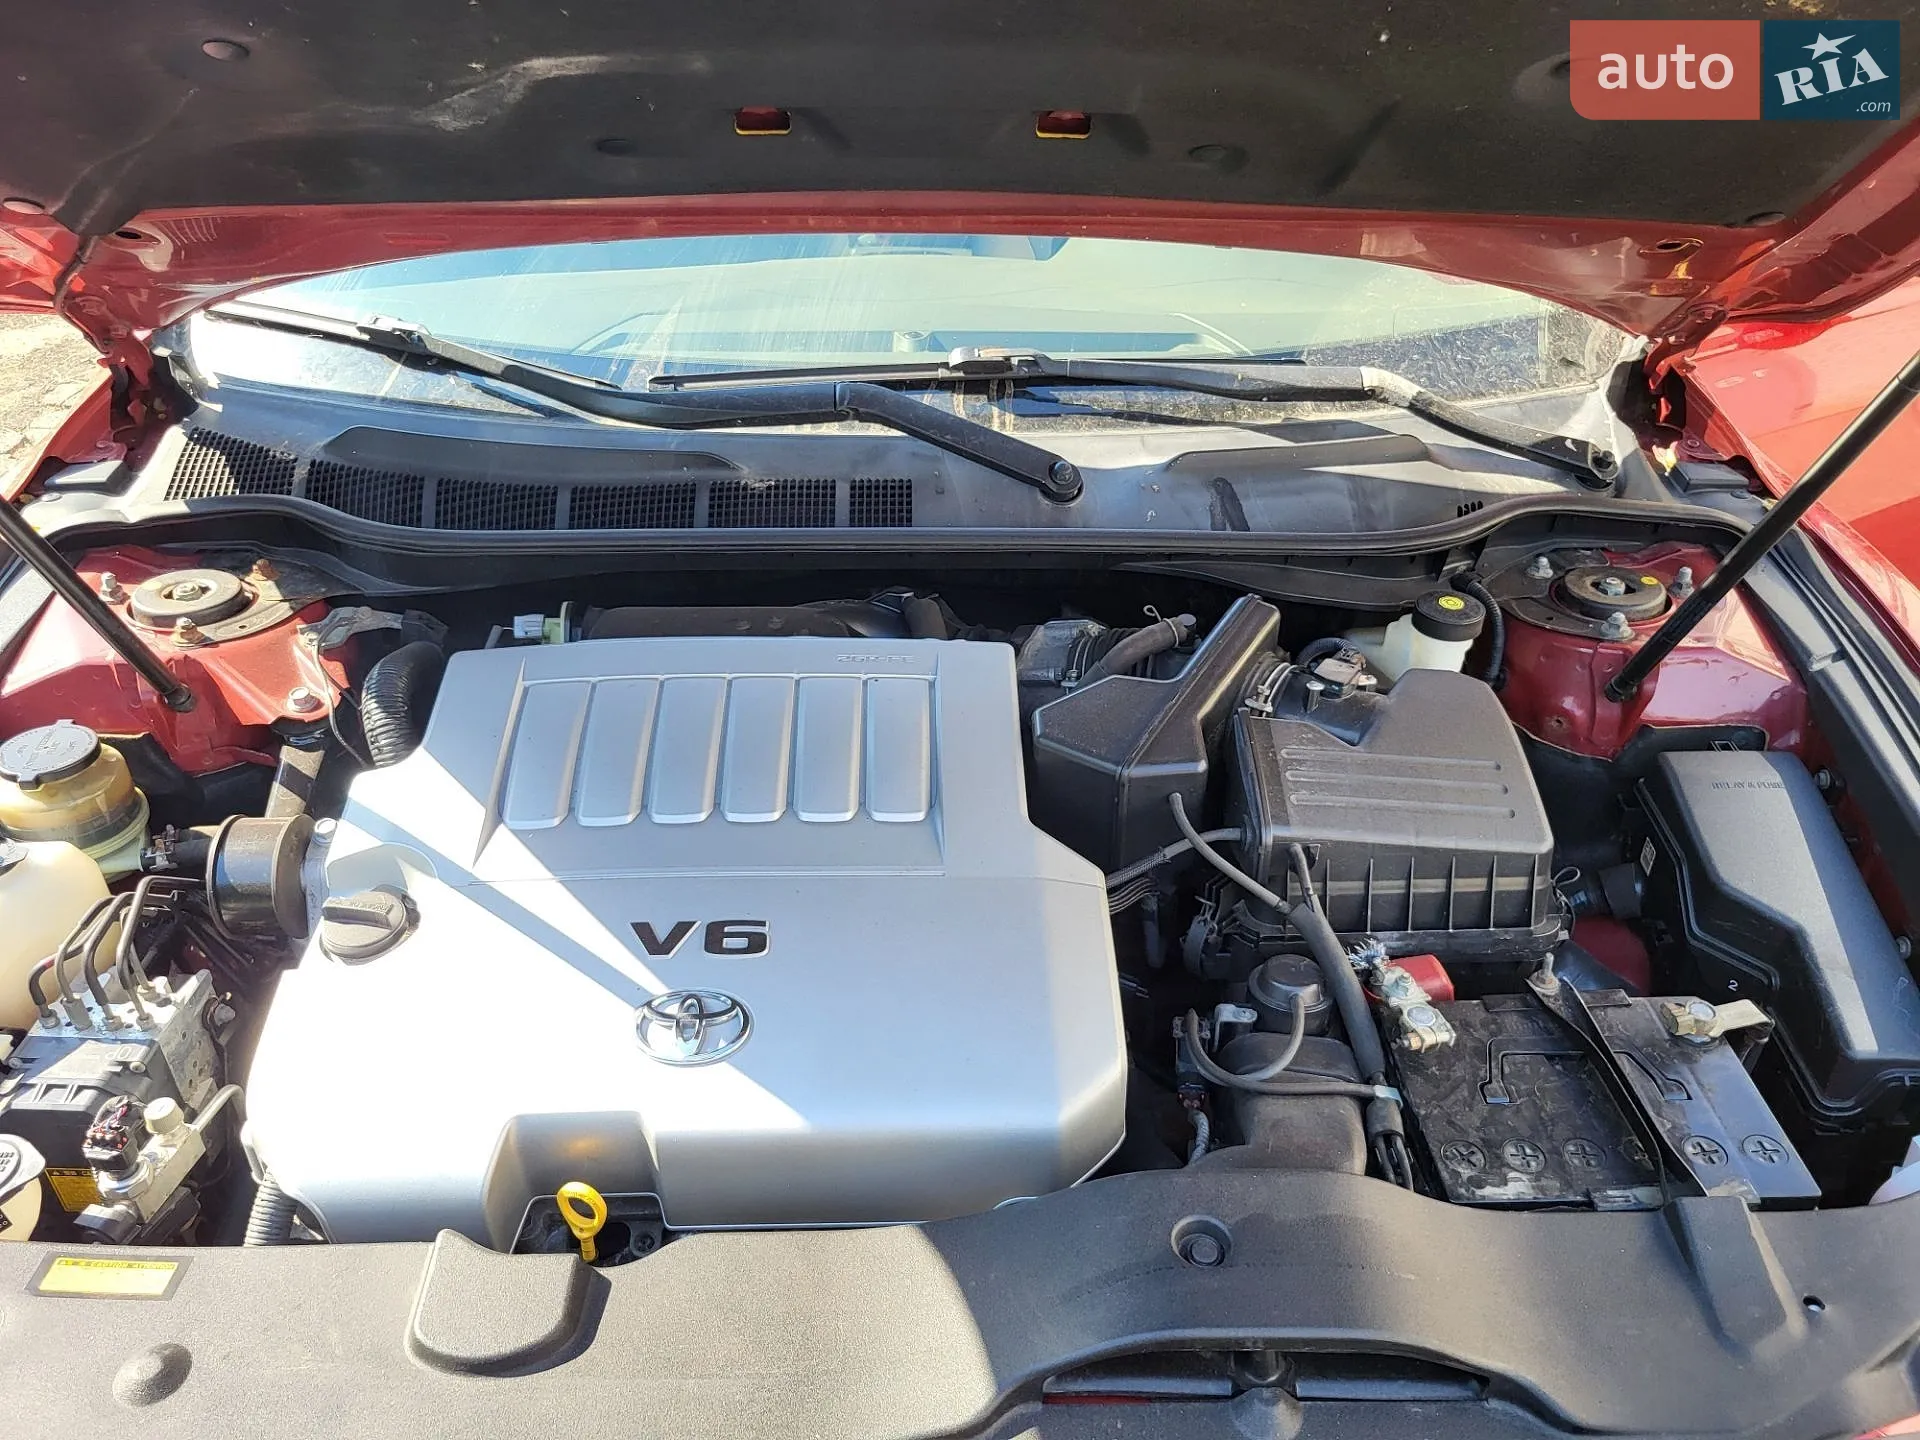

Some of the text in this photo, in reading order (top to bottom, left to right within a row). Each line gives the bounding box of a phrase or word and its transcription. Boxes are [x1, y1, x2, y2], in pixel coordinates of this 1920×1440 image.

[1711, 780, 1746, 790] RELAY
[1758, 780, 1785, 790] FUSE
[629, 919, 770, 958] V6
[1727, 979, 1739, 992] 2
